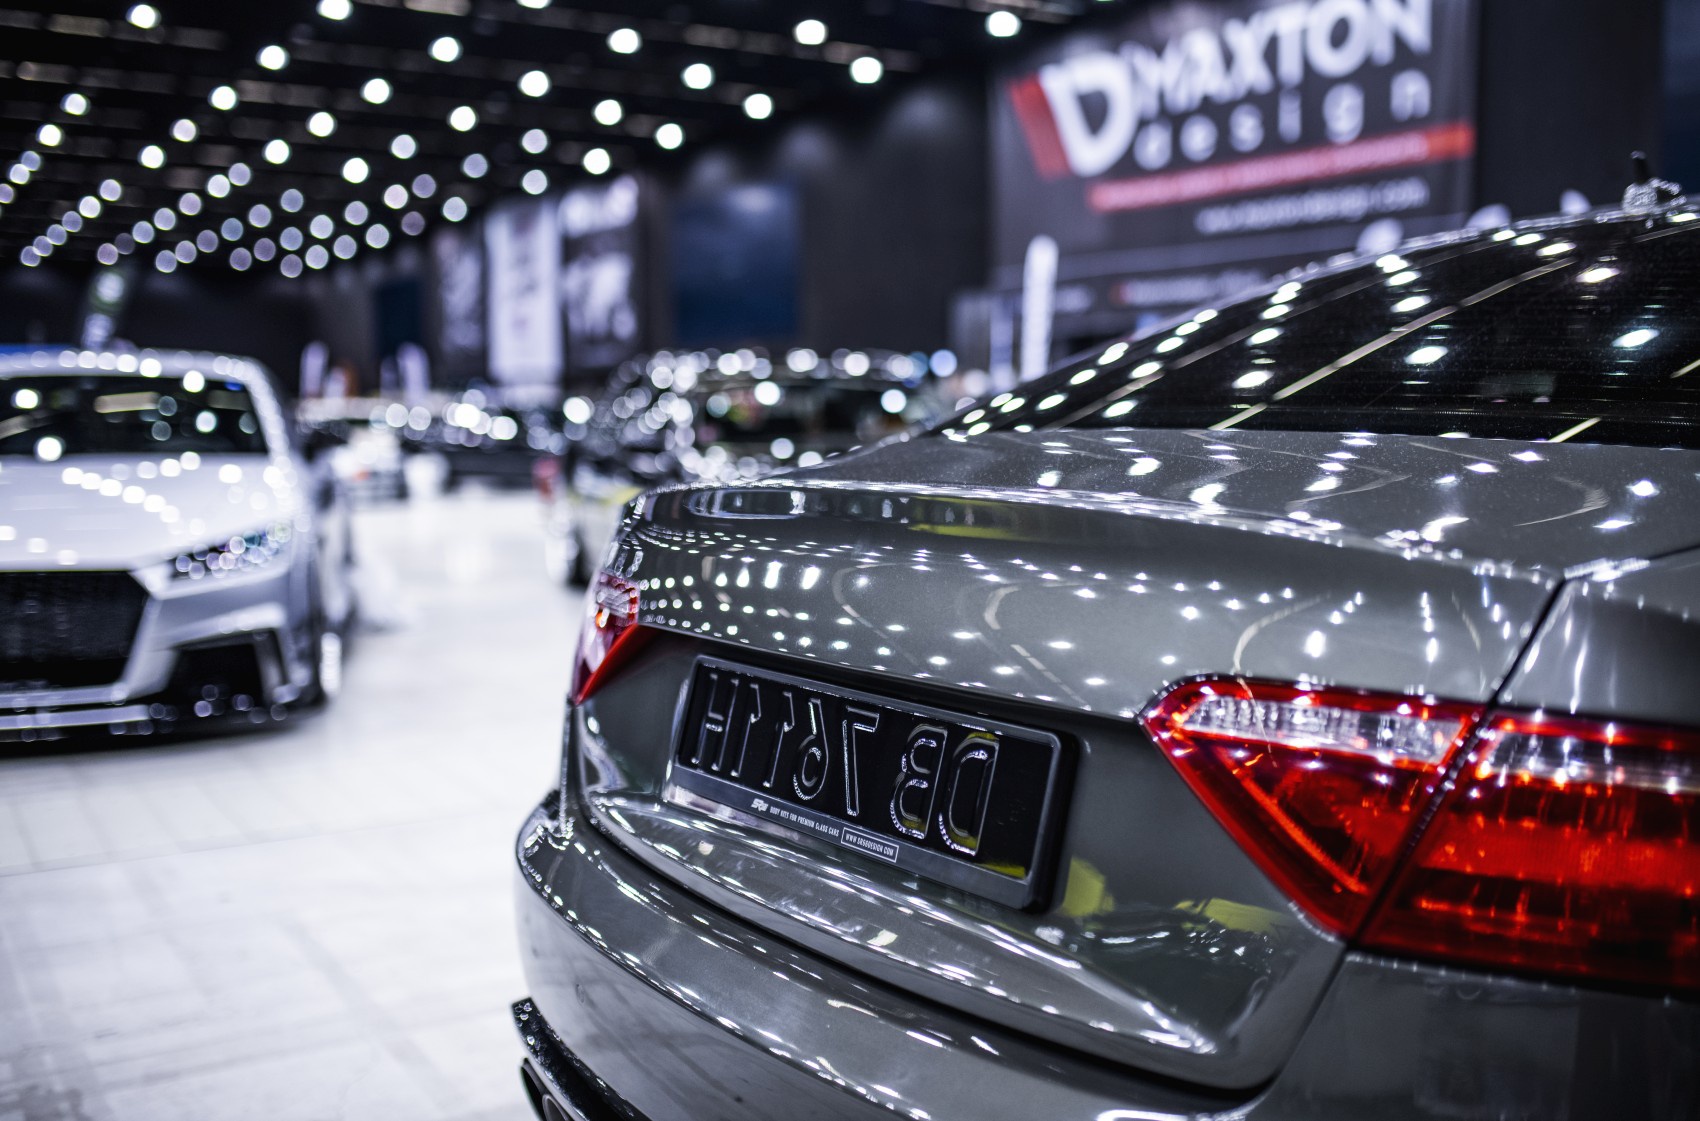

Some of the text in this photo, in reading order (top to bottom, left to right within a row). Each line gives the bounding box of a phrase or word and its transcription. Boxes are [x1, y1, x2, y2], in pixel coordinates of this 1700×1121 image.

[1133, 68, 1432, 171] design
[769, 806, 780, 816] BODY
[780, 809, 789, 819] KITS
[789, 812, 798, 821] FOR
[797, 815, 815, 828] PREMIUM
[828, 827, 840, 837] CARS
